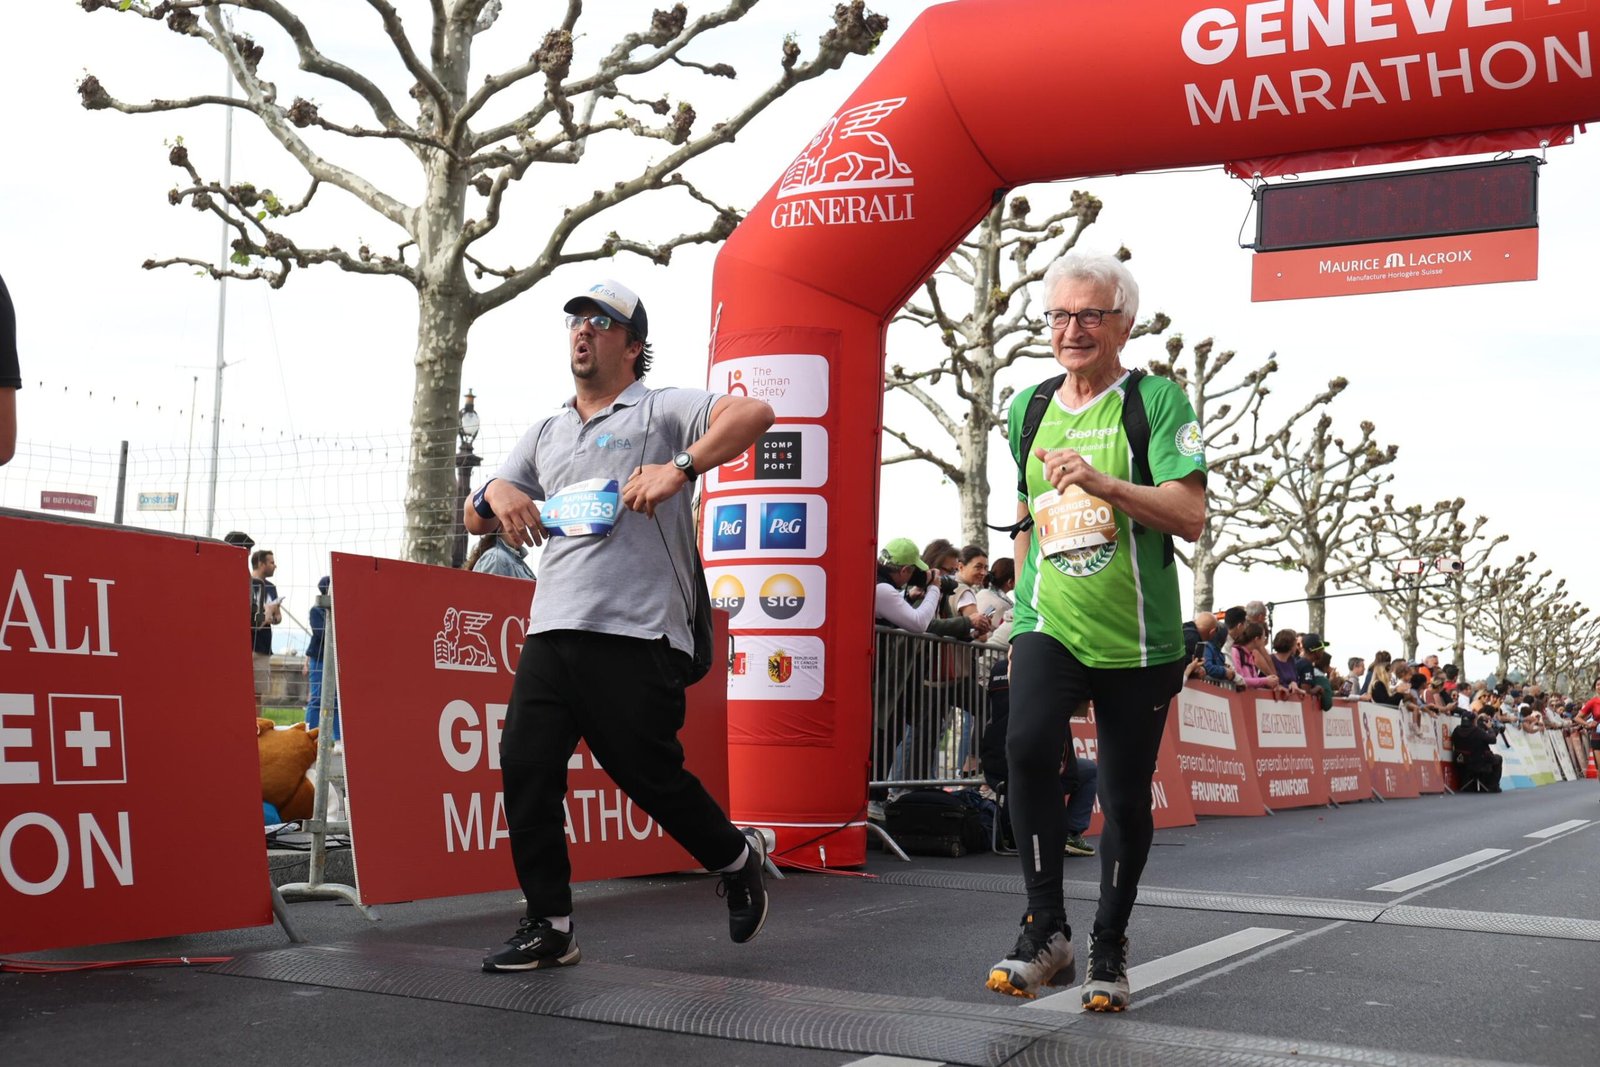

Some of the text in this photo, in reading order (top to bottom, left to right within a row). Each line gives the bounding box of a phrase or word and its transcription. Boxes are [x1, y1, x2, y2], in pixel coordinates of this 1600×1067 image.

[1184, 31, 1592, 126] MARATHON
[770, 193, 915, 229] GENERALI
[1319, 258, 1380, 274] MAURICE
[1409, 250, 1472, 266] LACROIX
[1346, 268, 1443, 282] Manufacture Horlogère Suisse
[752, 367, 772, 376] The
[752, 377, 790, 387] Human
[752, 387, 786, 398] Safety
[1065, 424, 1119, 440] Georges
[764, 441, 793, 449] COMP
[764, 452, 793, 460] RESS
[559, 501, 614, 519] 20753
[717, 519, 743, 536] P&G
[769, 518, 802, 534] P&G
[1050, 506, 1111, 534] 17790
[715, 597, 739, 608] SIG
[767, 596, 798, 607] SIG
[1194, 706, 1230, 735] GENERALI
[1191, 780, 1239, 803] #RUNFORIT
[1269, 778, 1309, 797] #RUNFORIT
